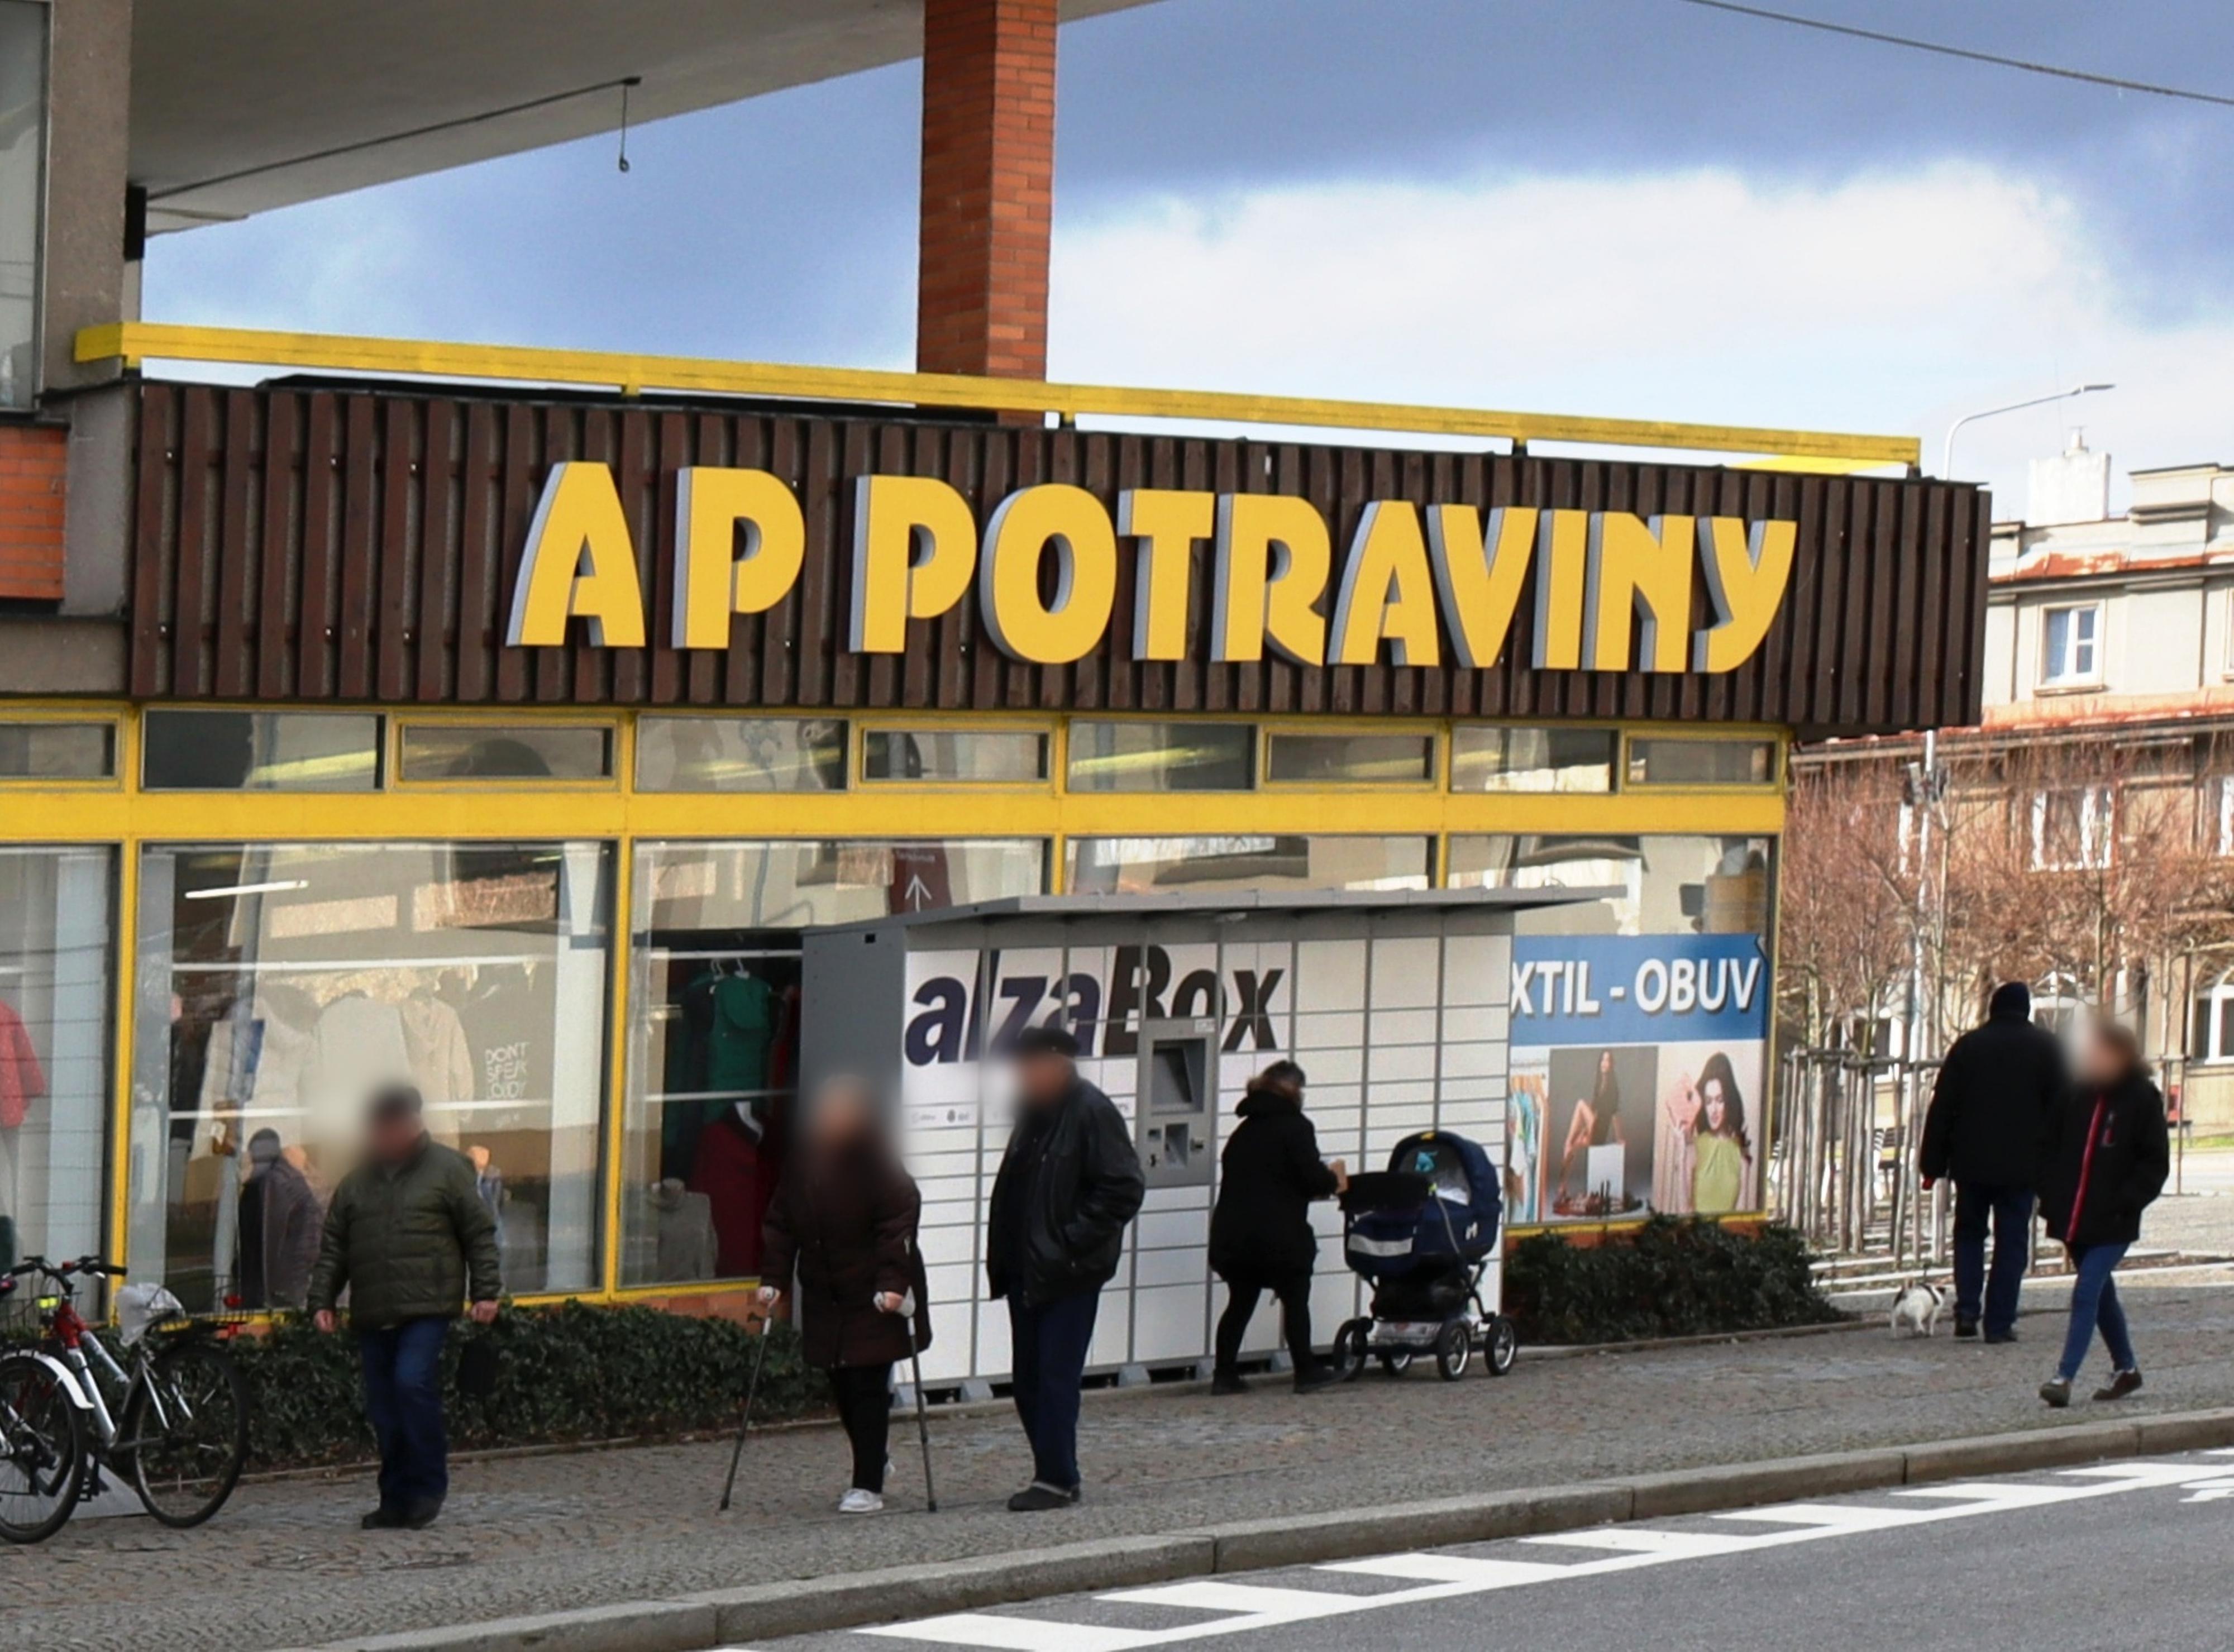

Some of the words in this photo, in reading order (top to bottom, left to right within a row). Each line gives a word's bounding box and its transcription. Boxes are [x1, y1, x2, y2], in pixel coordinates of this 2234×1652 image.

[505, 461, 805, 649] AP
[848, 474, 1797, 673] POTRAVINY
[904, 944, 1285, 1066] alzaBox
[1634, 958, 1761, 1013] OBUV
